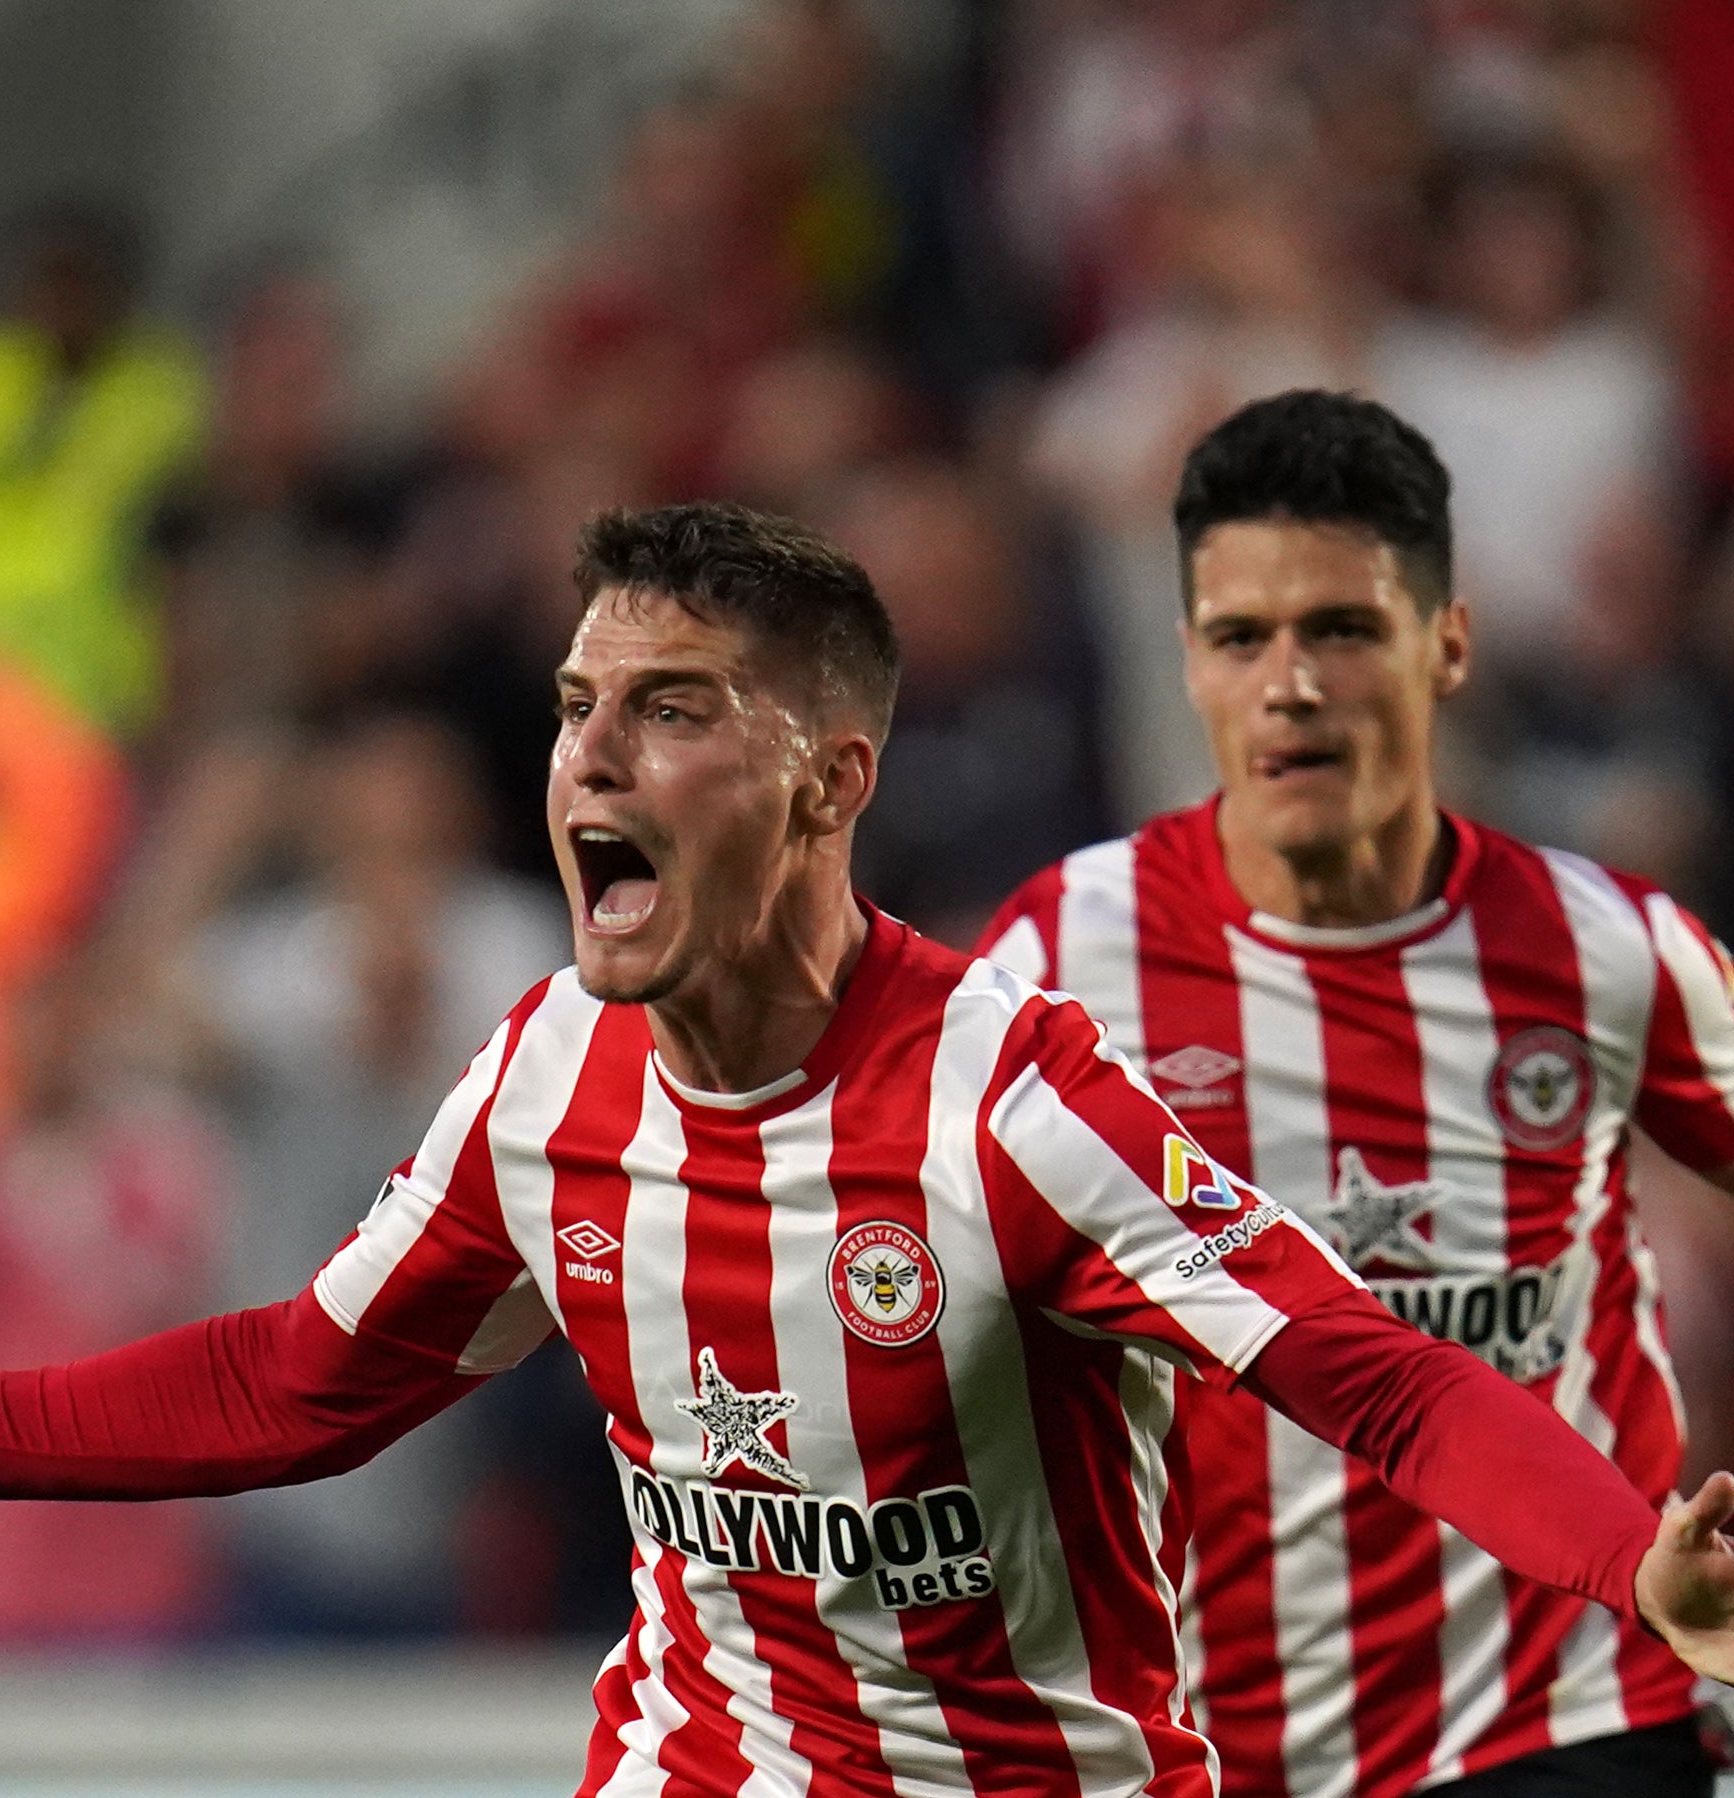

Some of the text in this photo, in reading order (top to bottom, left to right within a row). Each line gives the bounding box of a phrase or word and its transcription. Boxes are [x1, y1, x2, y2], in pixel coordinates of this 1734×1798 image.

[841, 1228, 921, 1260] BRENTFORD
[565, 1261, 613, 1285] umbro
[846, 1310, 930, 1339] FOOTBALL CLUB
[632, 1470, 984, 1580] OLLYWOOD
[878, 1561, 993, 1608] bets
